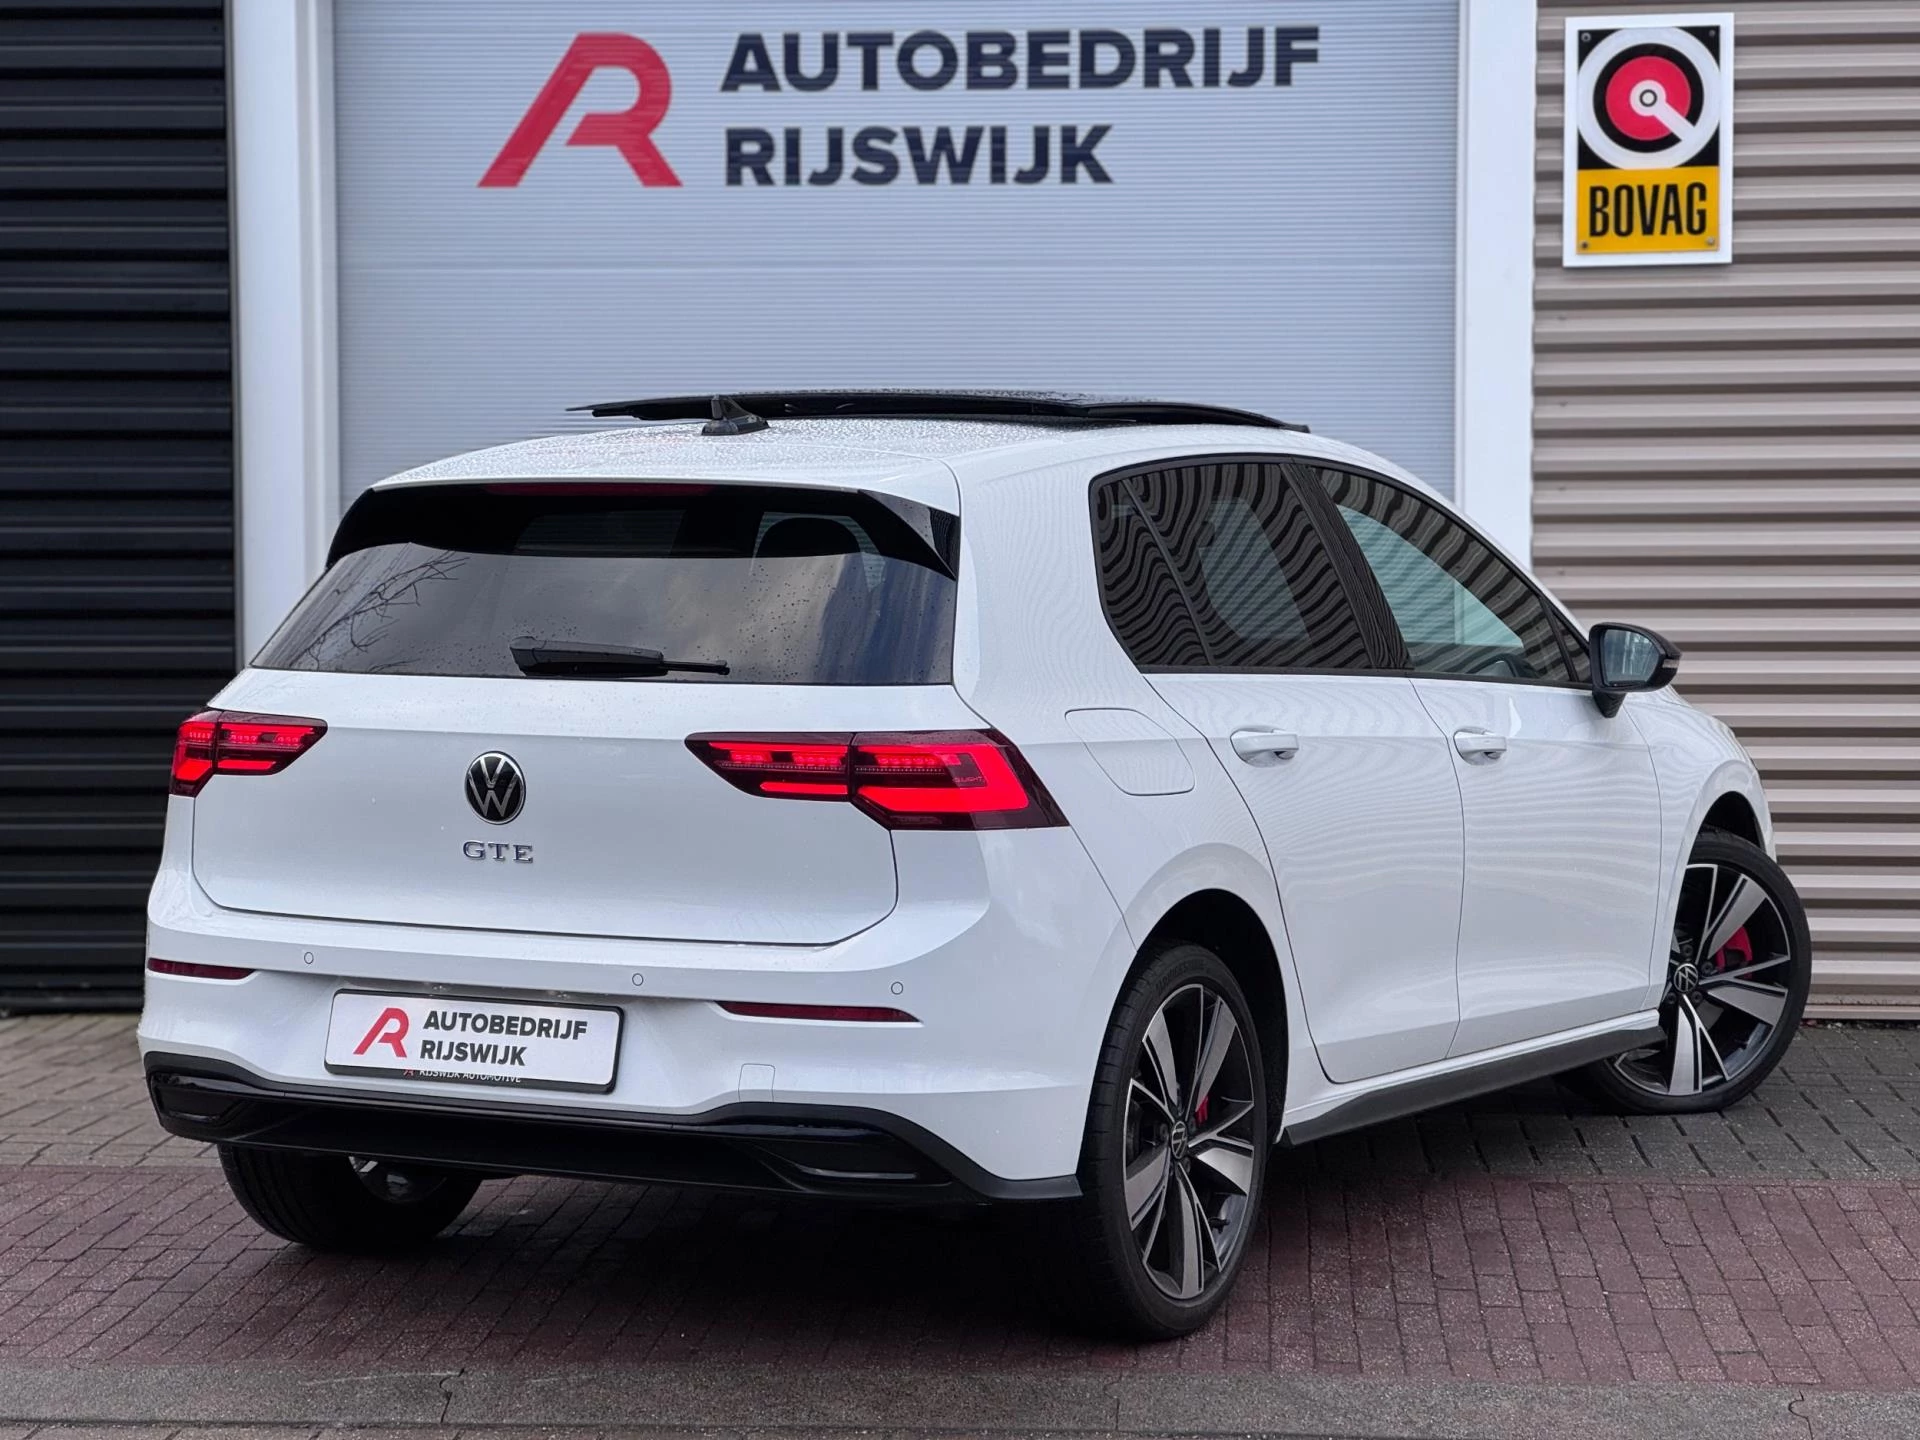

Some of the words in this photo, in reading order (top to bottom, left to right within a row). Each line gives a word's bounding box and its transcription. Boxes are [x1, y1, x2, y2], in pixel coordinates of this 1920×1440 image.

[720, 26, 1320, 92] AUTOBEDRIJF
[725, 125, 1113, 187] RIJSWIJK
[1589, 181, 1707, 237] BOVAG
[463, 840, 533, 863] GTE
[422, 1010, 588, 1040] AUTOBEDRIJF
[420, 1040, 527, 1066] RIJSWIJK
[462, 1072, 522, 1083] AUTOMOTIVE
